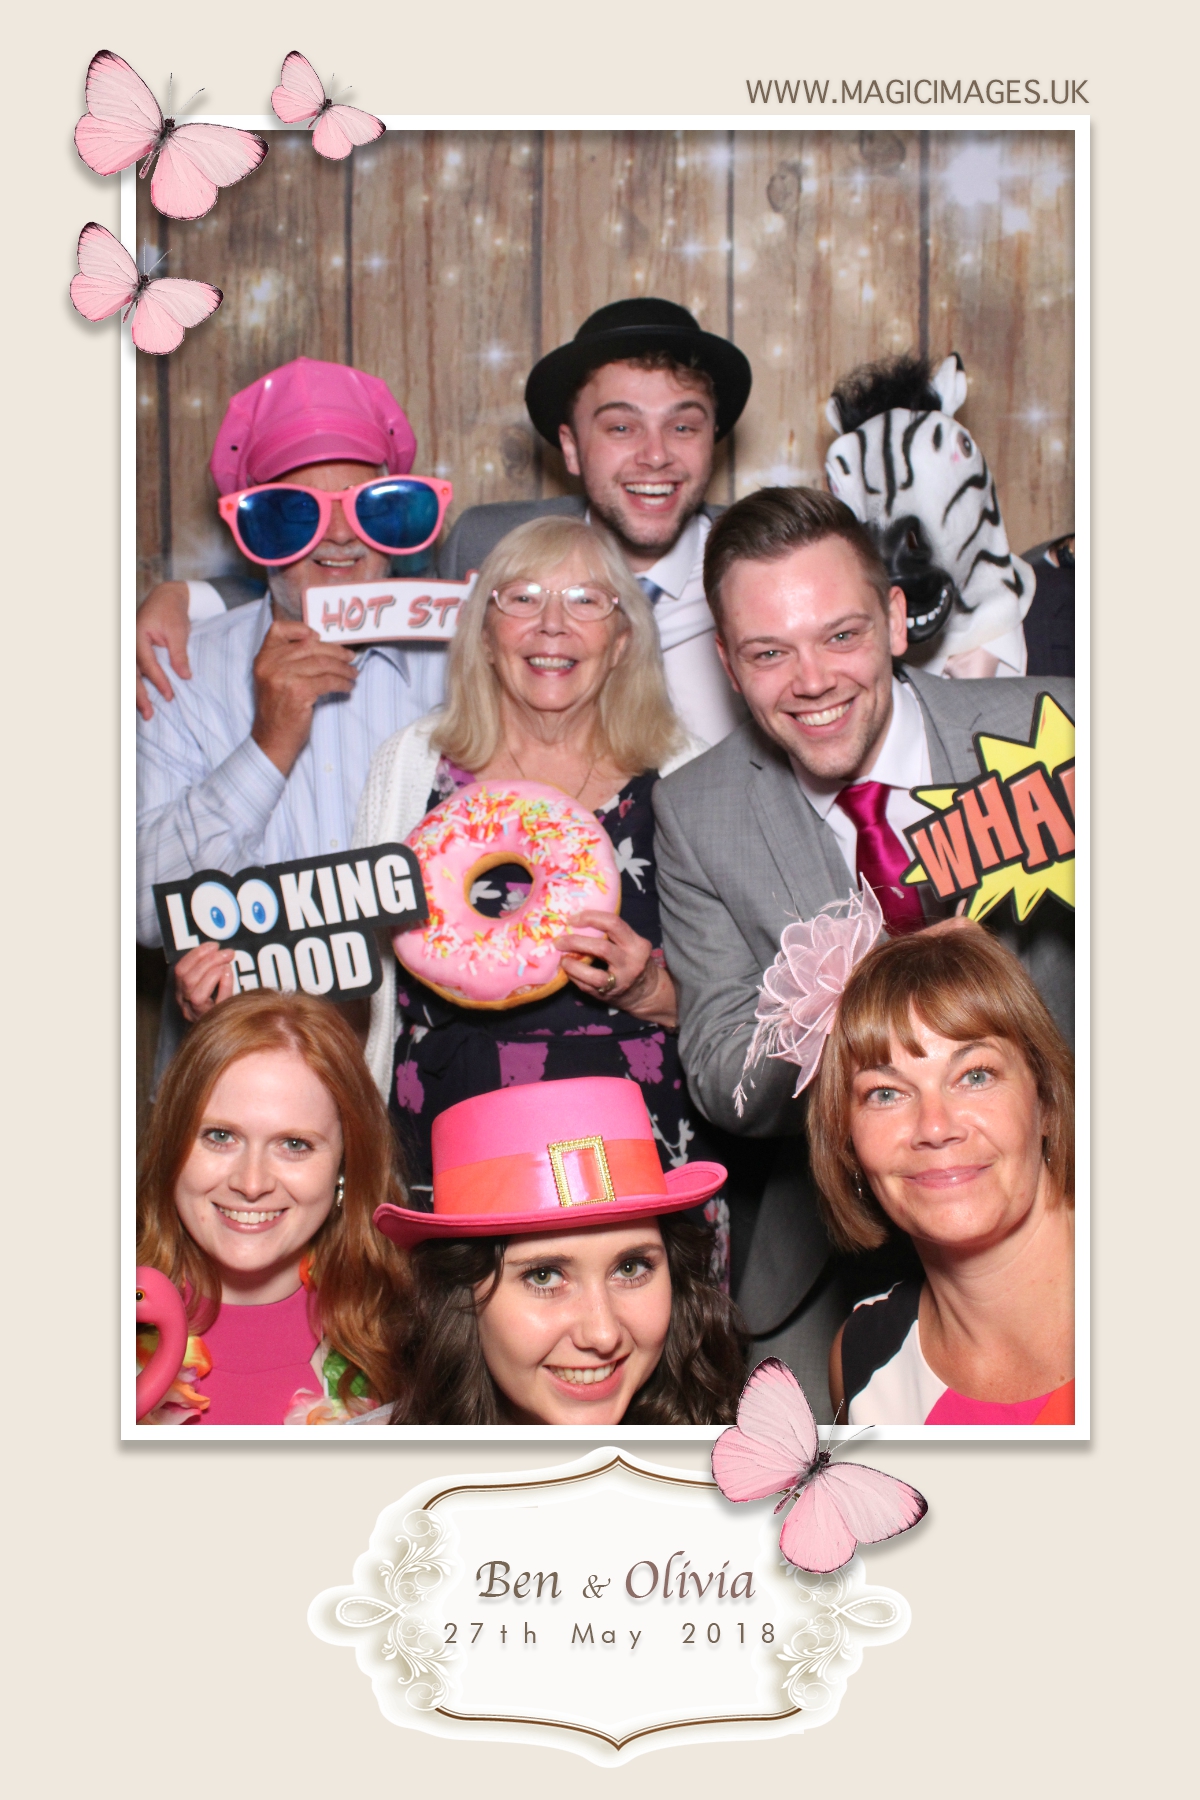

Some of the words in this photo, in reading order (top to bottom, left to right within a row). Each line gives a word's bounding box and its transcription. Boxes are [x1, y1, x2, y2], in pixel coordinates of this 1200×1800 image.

[321, 595, 397, 631] HOT
[911, 766, 1075, 897] WHA
[166, 854, 417, 951] LOOKING
[232, 931, 373, 996] GOOD
